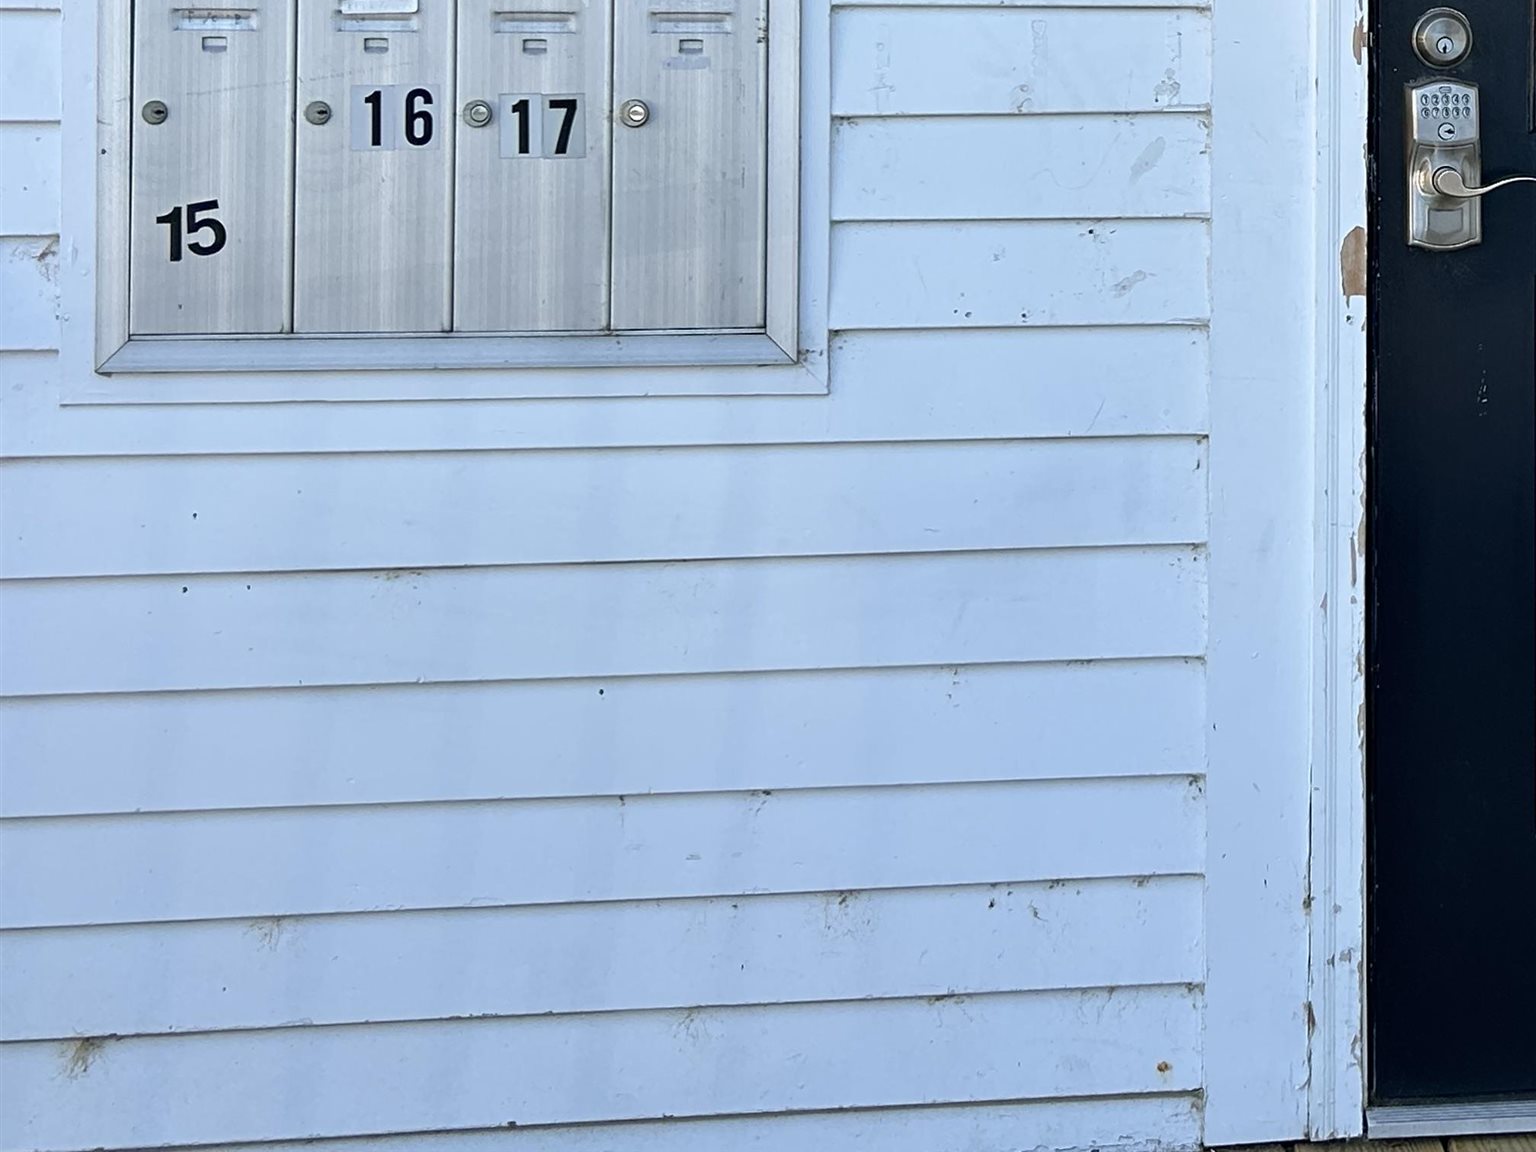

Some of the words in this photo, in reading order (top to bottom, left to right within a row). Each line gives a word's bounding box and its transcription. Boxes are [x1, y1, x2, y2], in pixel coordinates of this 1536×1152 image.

[365, 89, 433, 146] 16
[512, 99, 577, 154] 17
[157, 200, 226, 261] 15
